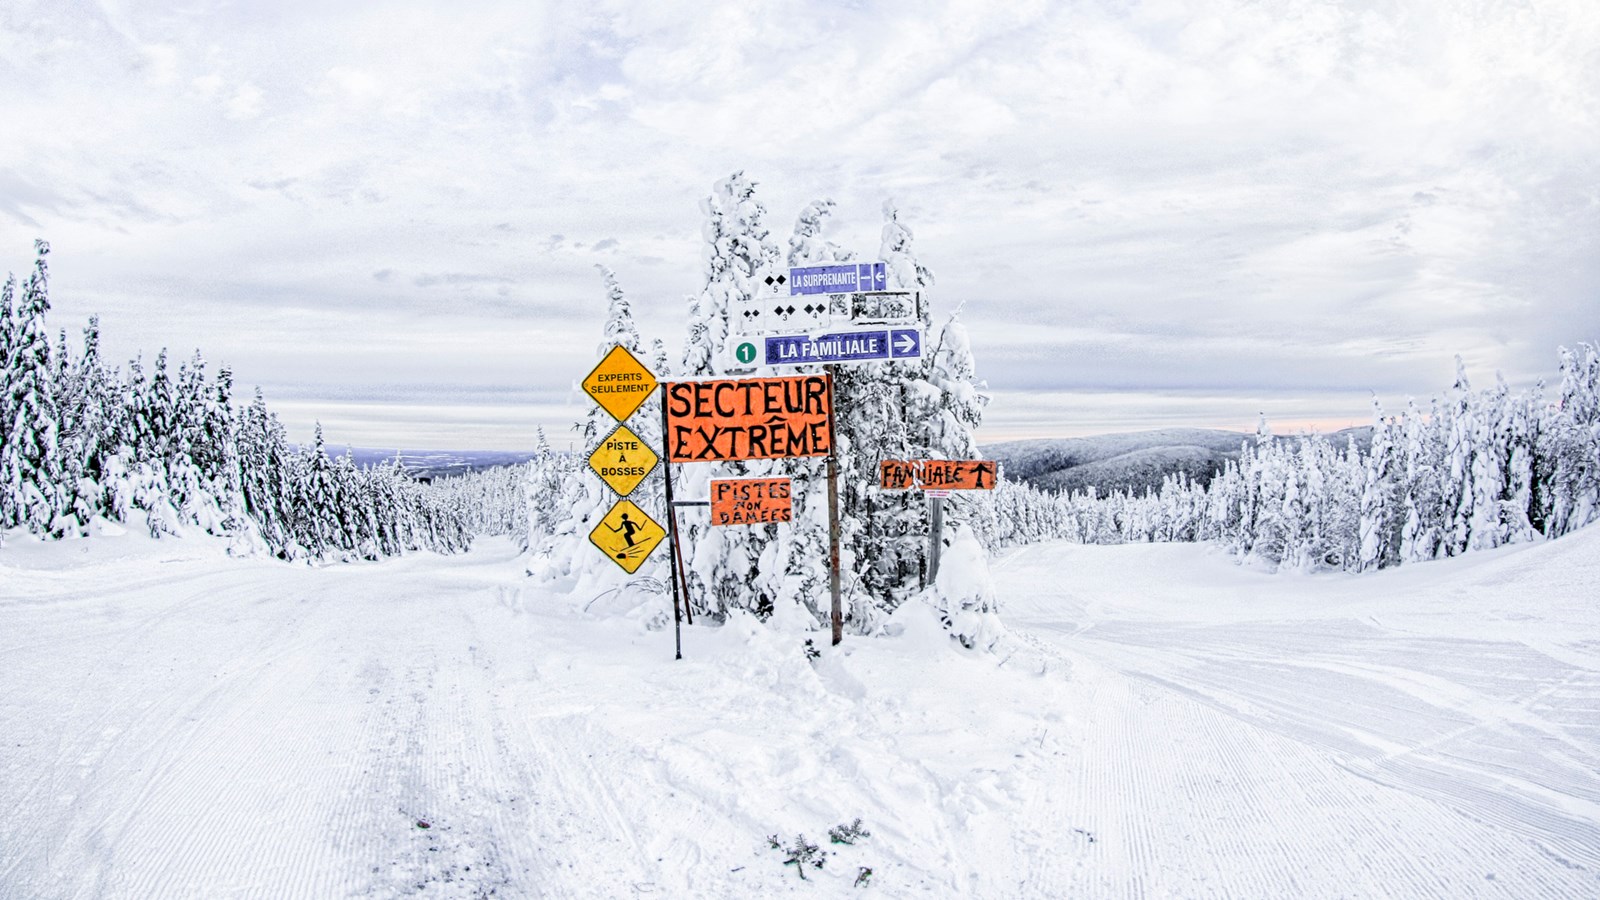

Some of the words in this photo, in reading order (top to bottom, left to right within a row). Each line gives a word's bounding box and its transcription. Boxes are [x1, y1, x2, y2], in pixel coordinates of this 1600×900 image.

[792, 275, 802, 288] LA
[803, 271, 856, 287] SURPRENANTE
[773, 285, 779, 293] 5
[779, 343, 798, 359] LA
[802, 338, 878, 357] FAMILIALE
[597, 372, 642, 382] EXPERTS
[591, 384, 650, 394] SEULEMENT
[670, 376, 826, 419] SECTEUR
[673, 415, 829, 459] EXTRÊME
[601, 466, 645, 476] BOSSES
